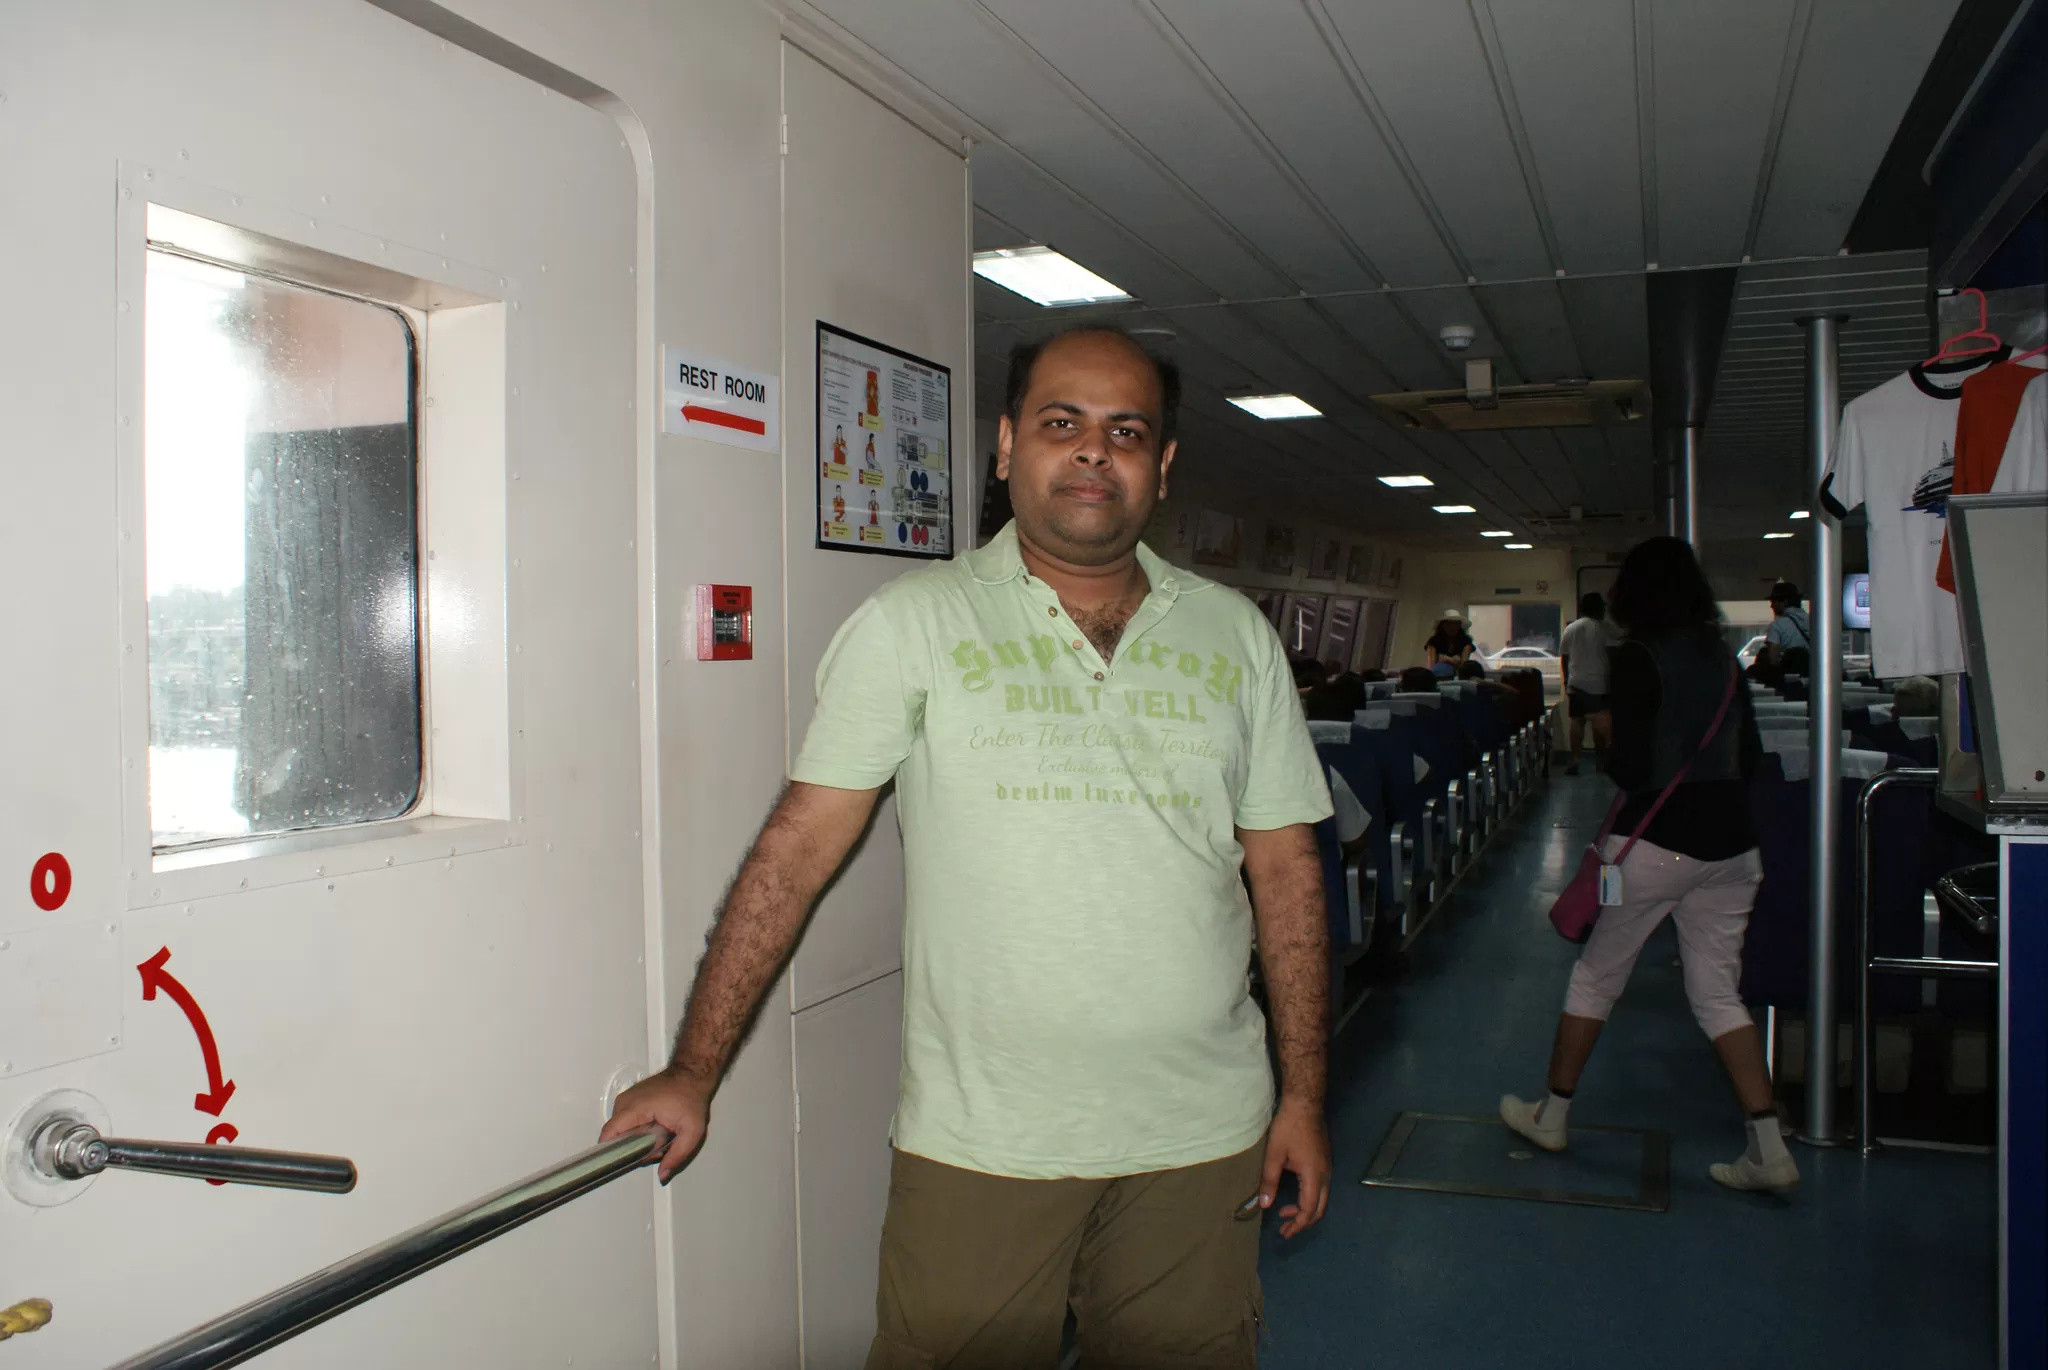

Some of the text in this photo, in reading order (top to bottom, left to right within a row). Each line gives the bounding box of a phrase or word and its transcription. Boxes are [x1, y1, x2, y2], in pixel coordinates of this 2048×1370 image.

[679, 363, 765, 403] REST ROOM
[1004, 683, 1103, 715] BUILT
[969, 724, 1026, 750] Enter
[1036, 722, 1074, 748] The
[995, 780, 1073, 802] denim
